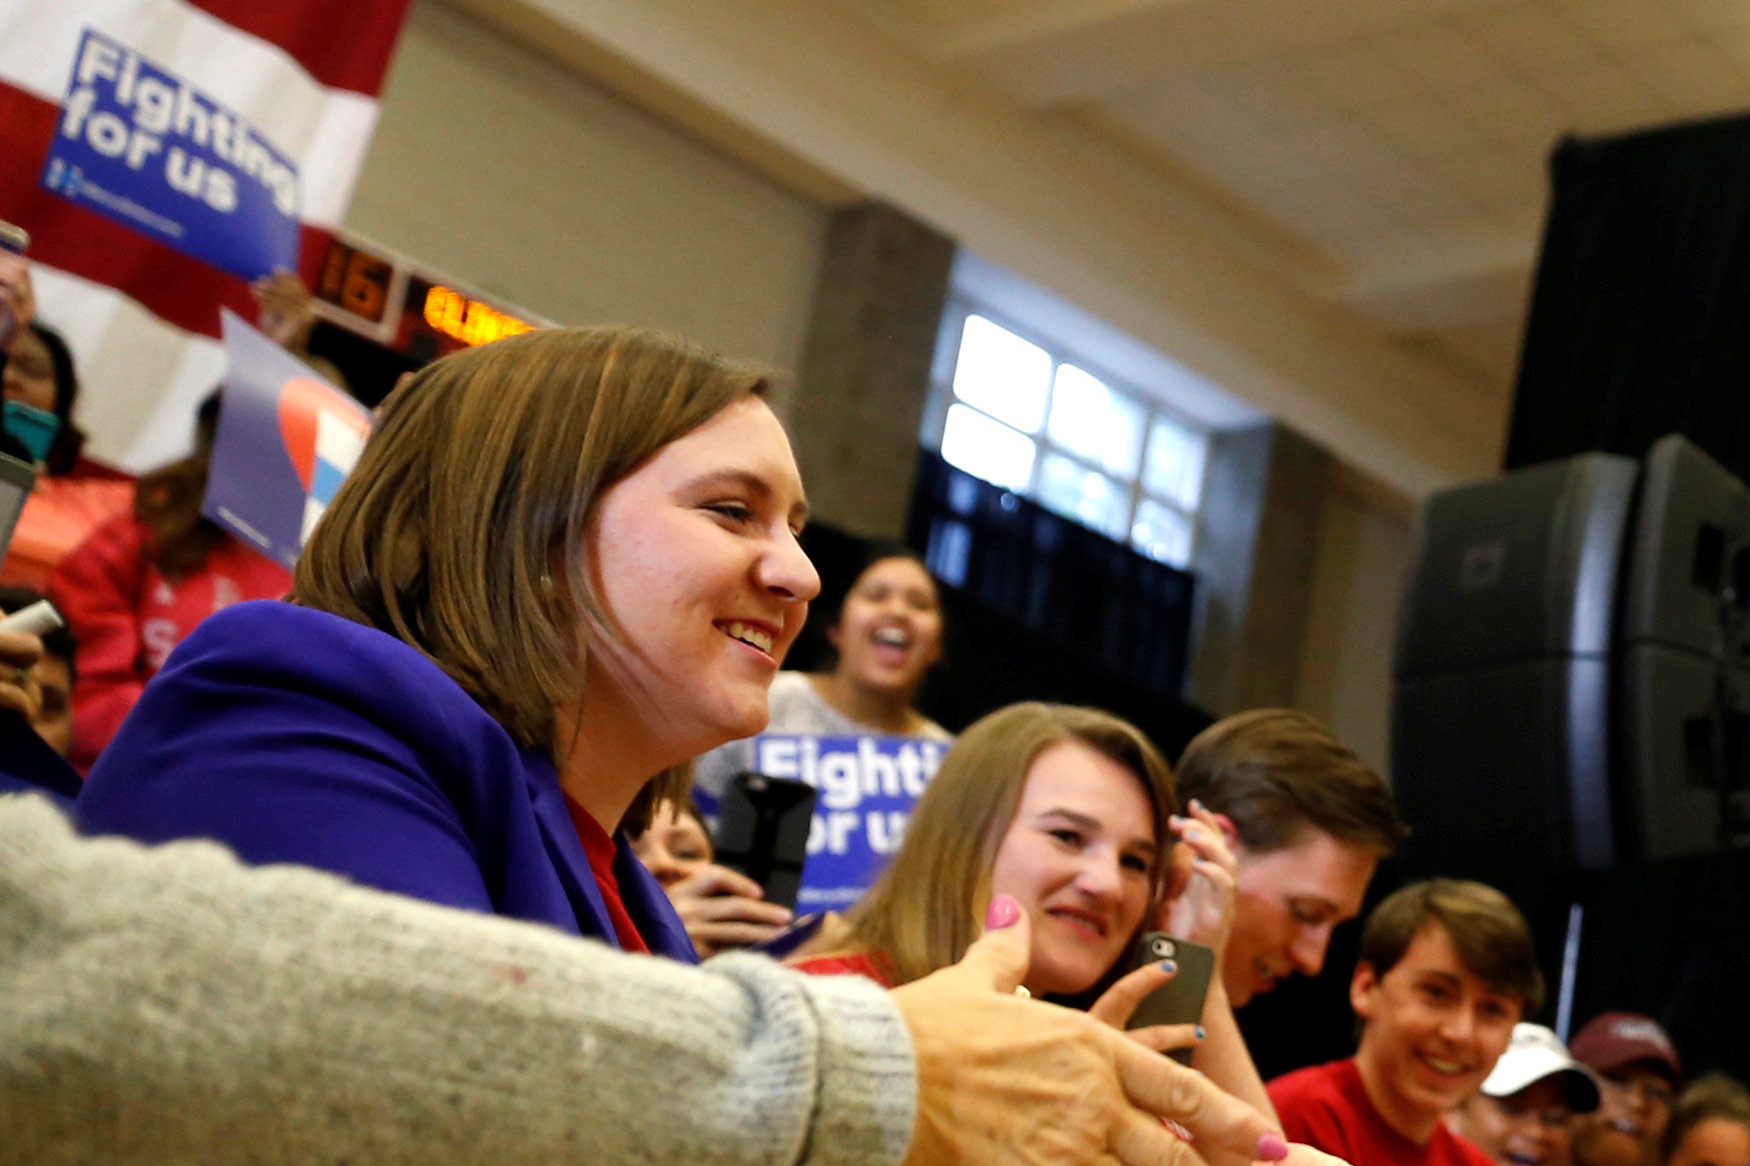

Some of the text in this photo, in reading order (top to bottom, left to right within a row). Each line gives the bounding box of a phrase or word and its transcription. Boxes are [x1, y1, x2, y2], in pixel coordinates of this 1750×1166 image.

[62, 87, 162, 171] for
[164, 146, 238, 213] us
[78, 38, 298, 216] Fighting
[805, 811, 861, 855] or
